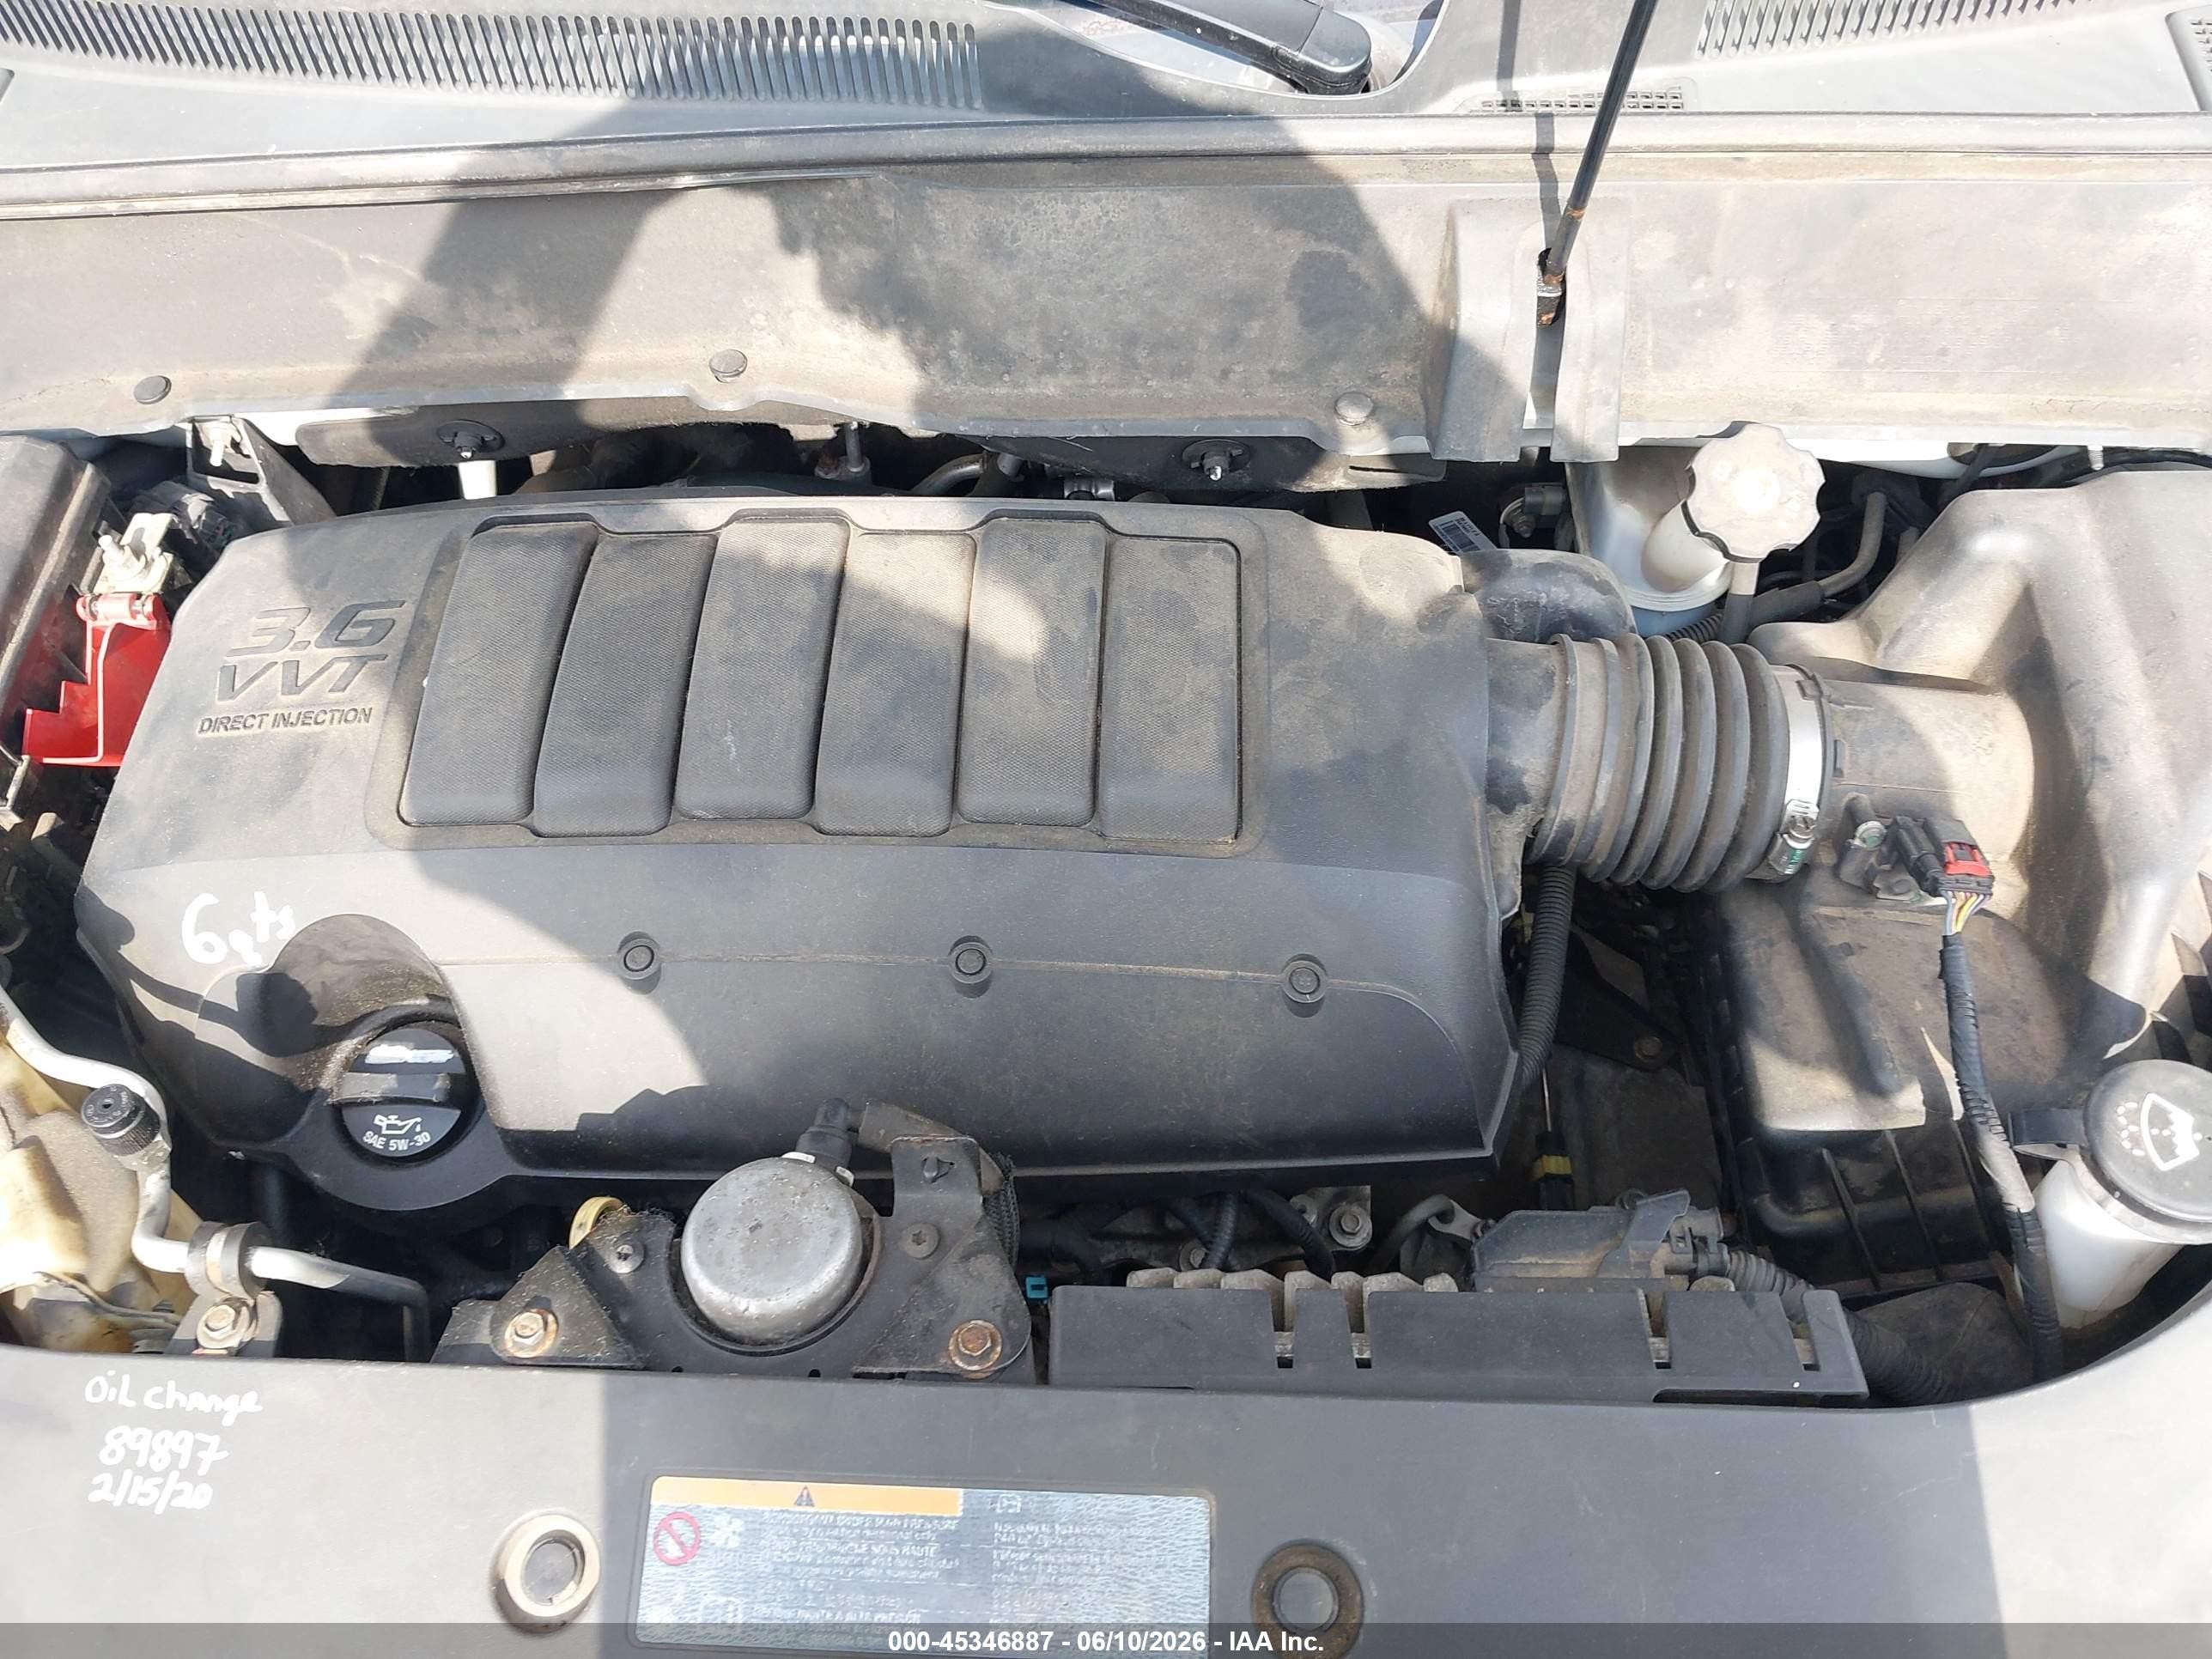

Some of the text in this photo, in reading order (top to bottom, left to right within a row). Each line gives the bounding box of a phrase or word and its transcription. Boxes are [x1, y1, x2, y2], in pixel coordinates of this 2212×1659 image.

[225, 599, 406, 658] 3.6
[216, 653, 389, 702] VVT
[198, 707, 374, 735] DIRECT INJECTION
[362, 1130, 431, 1152] SAE 5W-30
[98, 1425, 230, 1476] 89897
[88, 1468, 214, 1515] 2/15/20
